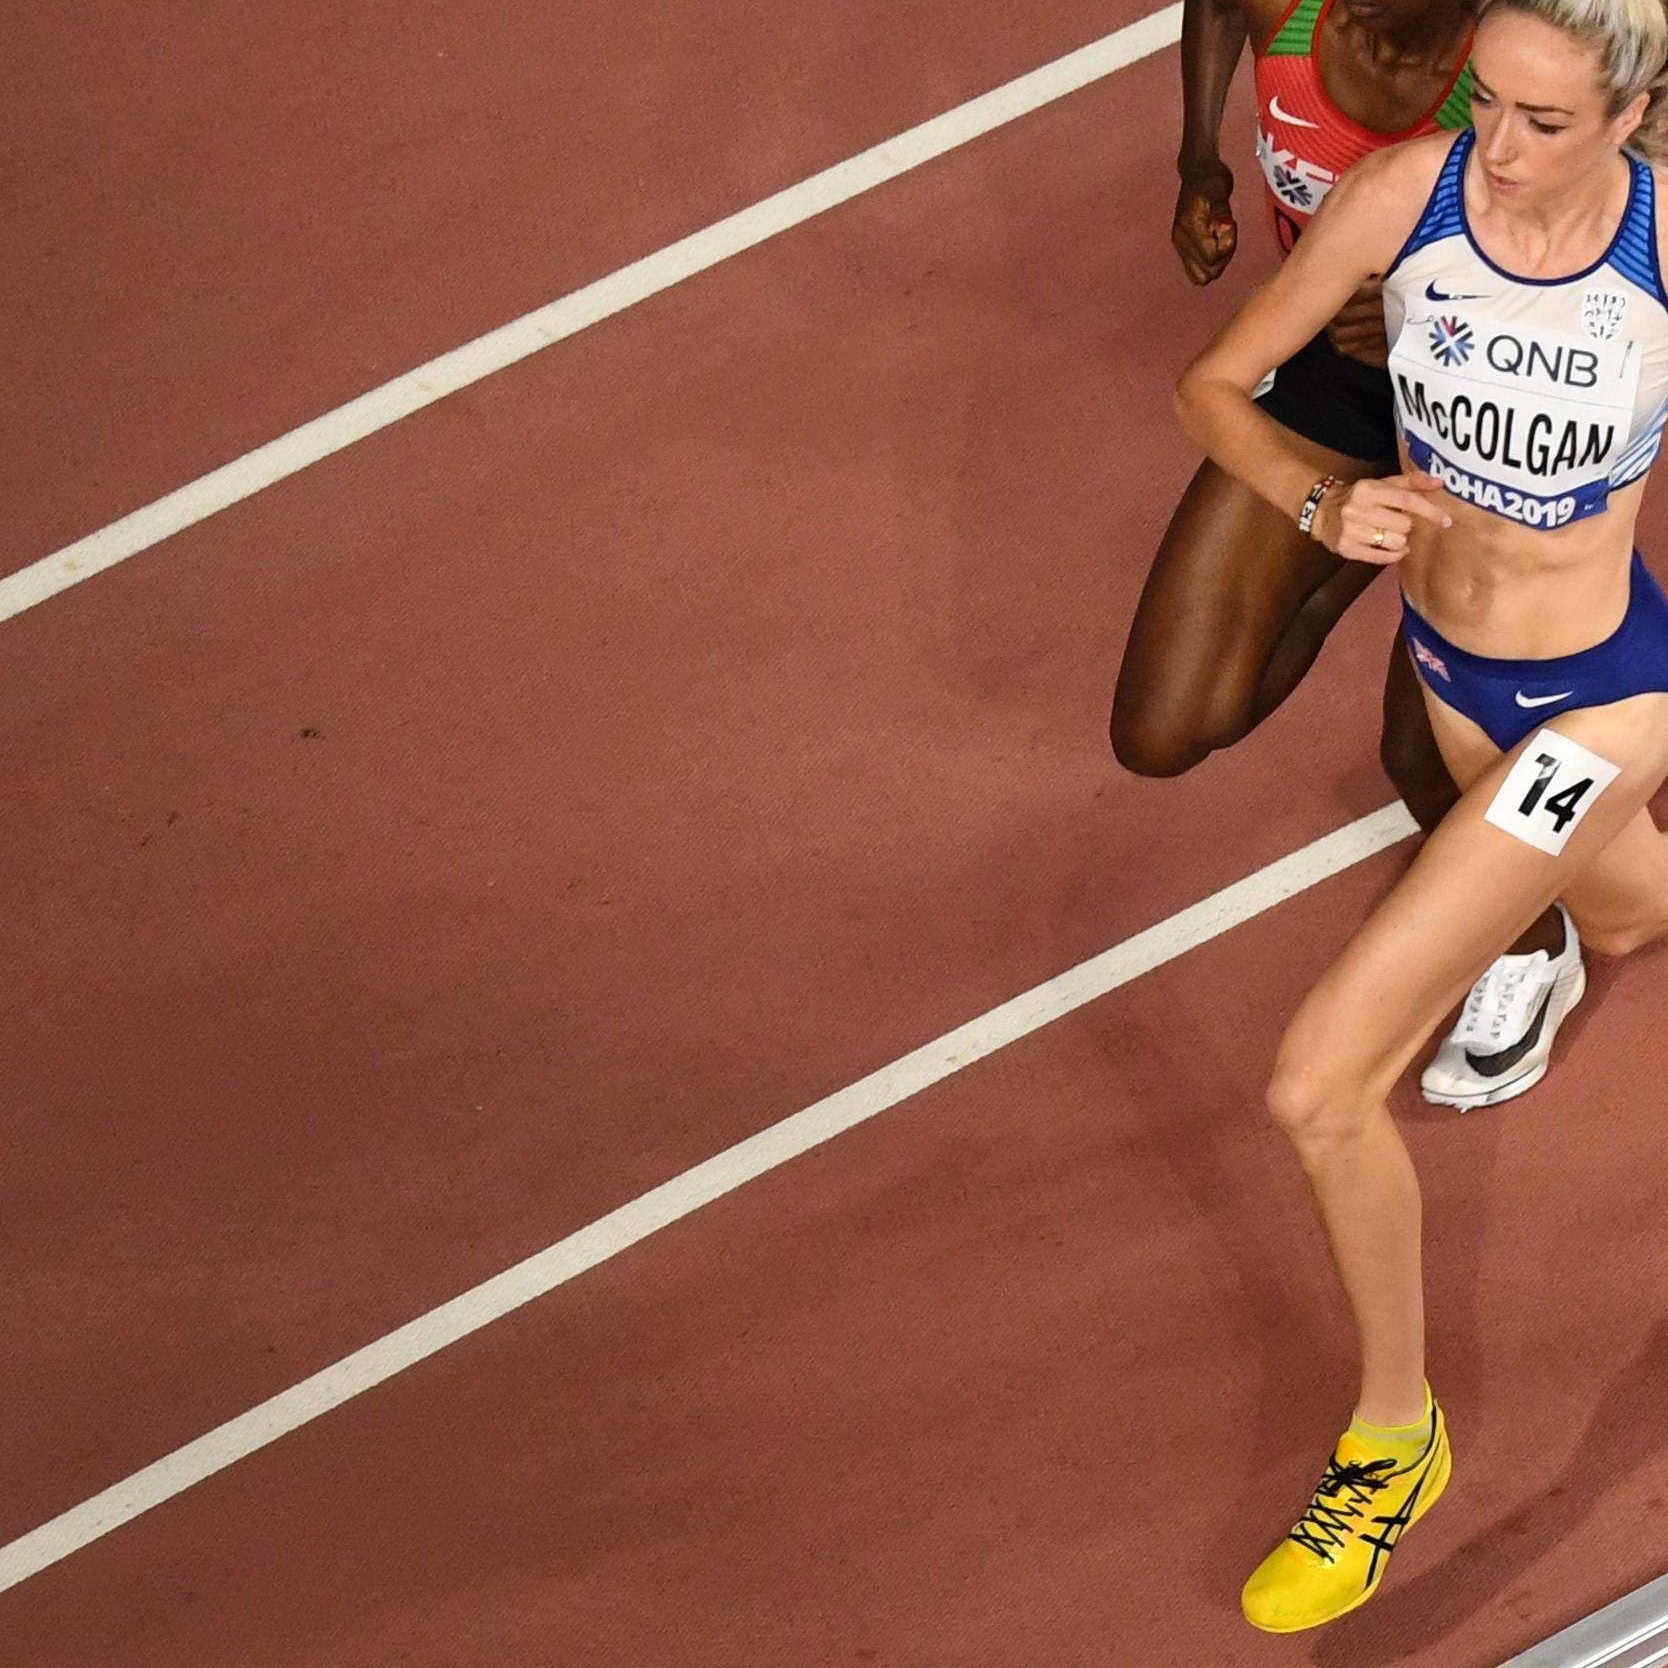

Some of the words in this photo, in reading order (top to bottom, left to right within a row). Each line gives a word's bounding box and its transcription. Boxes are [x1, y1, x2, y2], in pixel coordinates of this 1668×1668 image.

[1486, 335, 1599, 388] QNB
[1397, 373, 1615, 477] McCOLGAN
[1429, 453, 1576, 528] DOHA2019
[1518, 753, 1595, 834] 14
